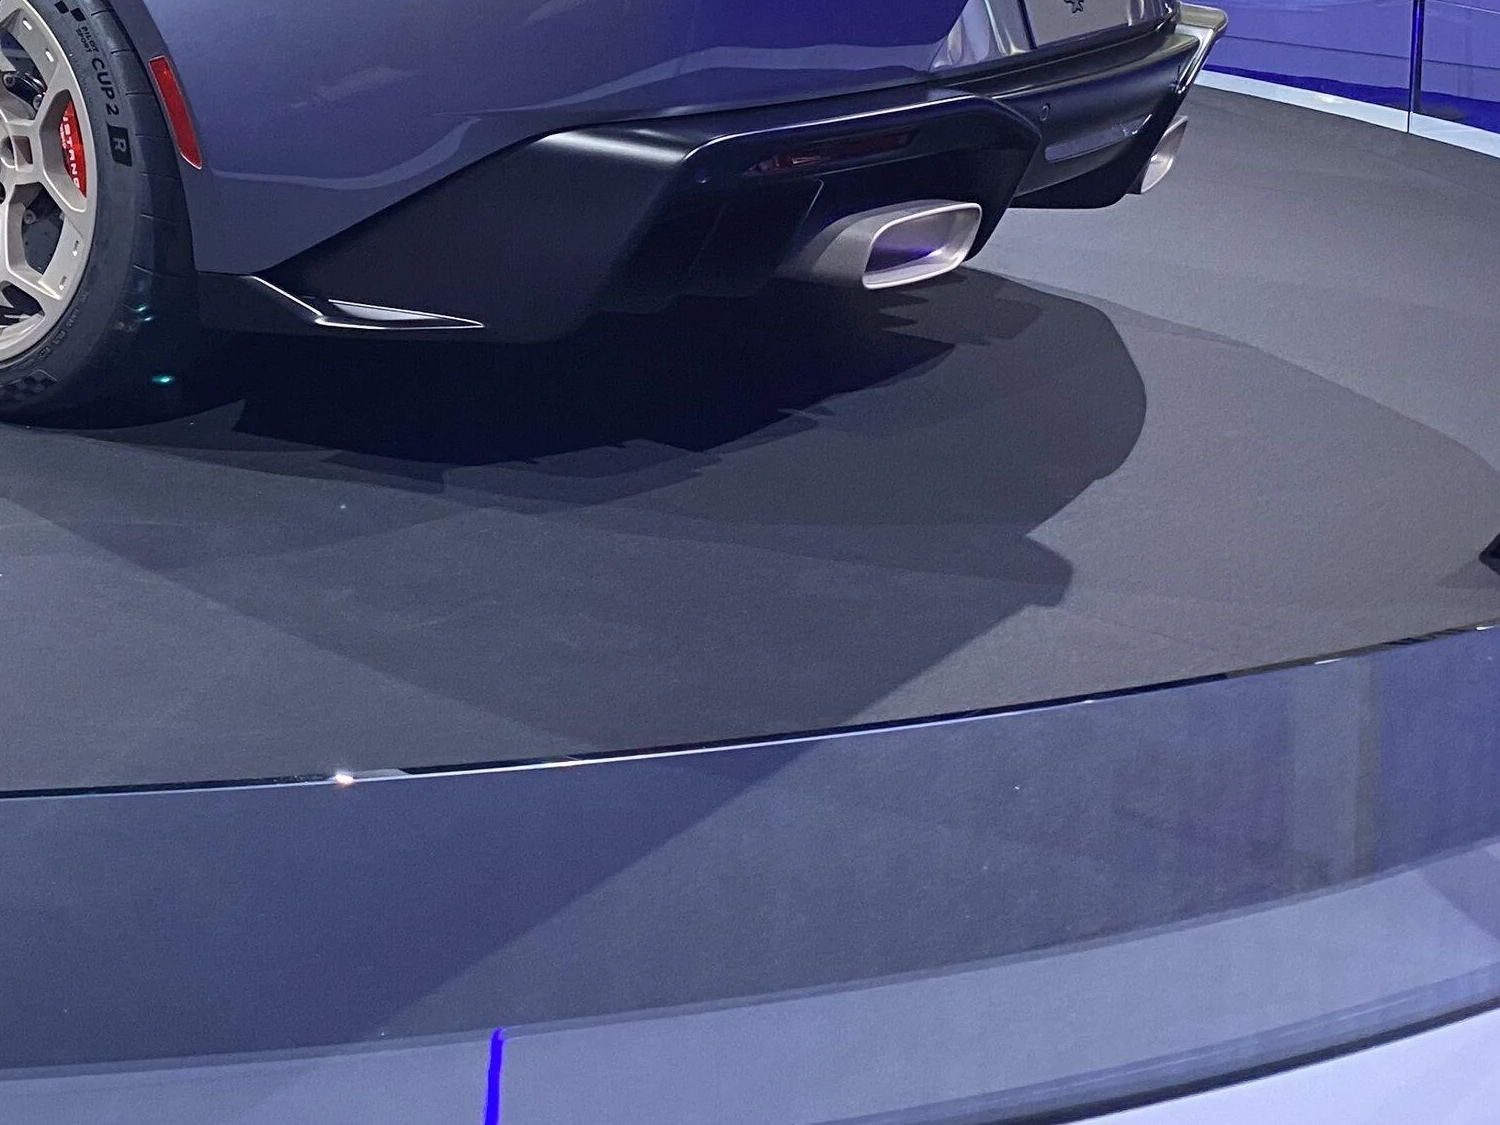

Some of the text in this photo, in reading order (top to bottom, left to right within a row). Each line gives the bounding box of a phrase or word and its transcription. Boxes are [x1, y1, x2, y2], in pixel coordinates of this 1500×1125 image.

[91, 57, 120, 116] CUP 2
[113, 137, 127, 152] R
